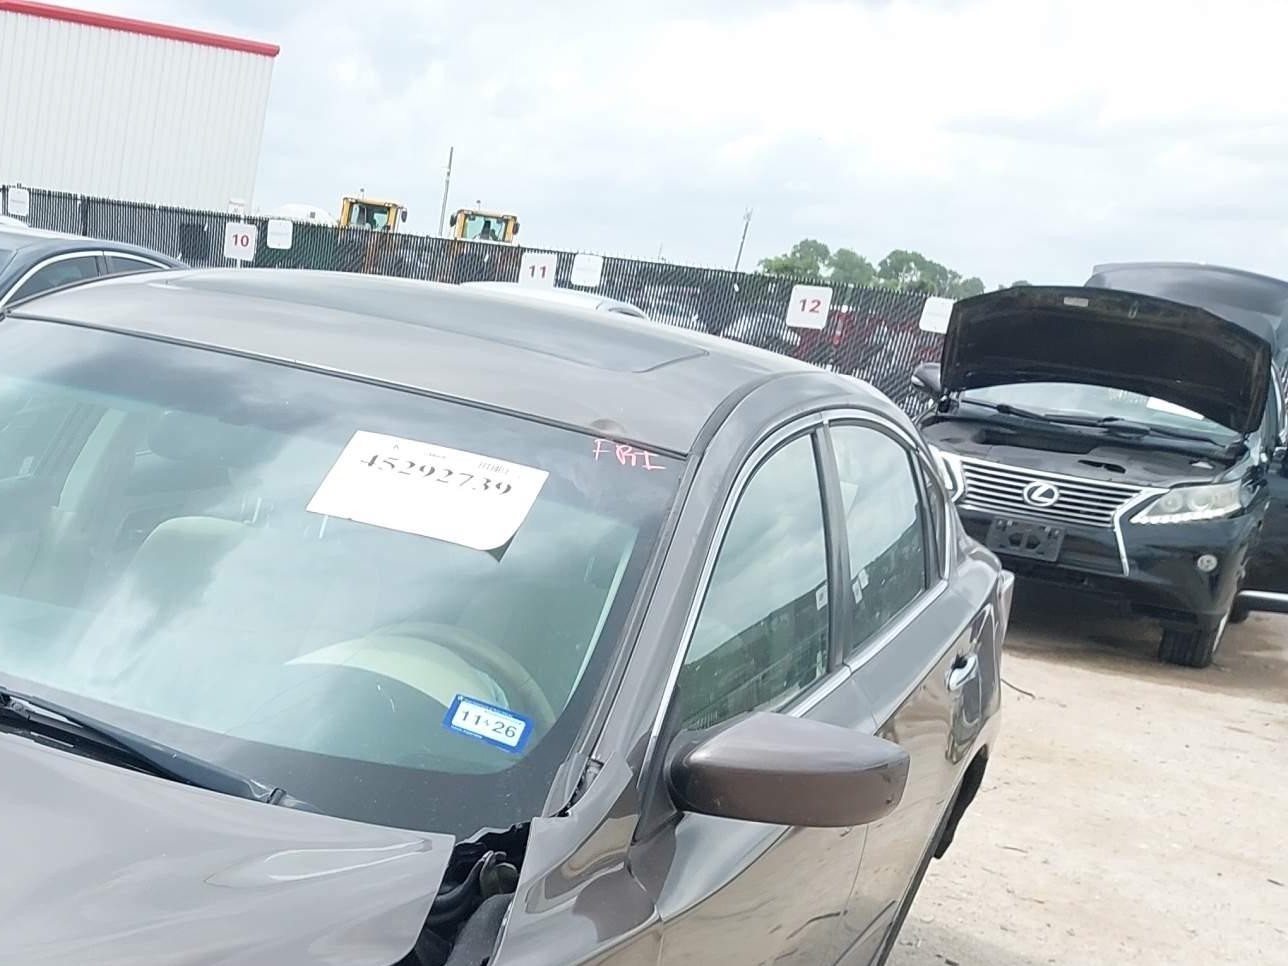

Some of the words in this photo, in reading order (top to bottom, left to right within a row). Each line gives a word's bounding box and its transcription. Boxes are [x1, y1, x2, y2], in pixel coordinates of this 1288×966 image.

[232, 233, 250, 247] 10
[529, 264, 547, 279] 11
[799, 298, 822, 314] 12
[491, 721, 518, 739] 26
